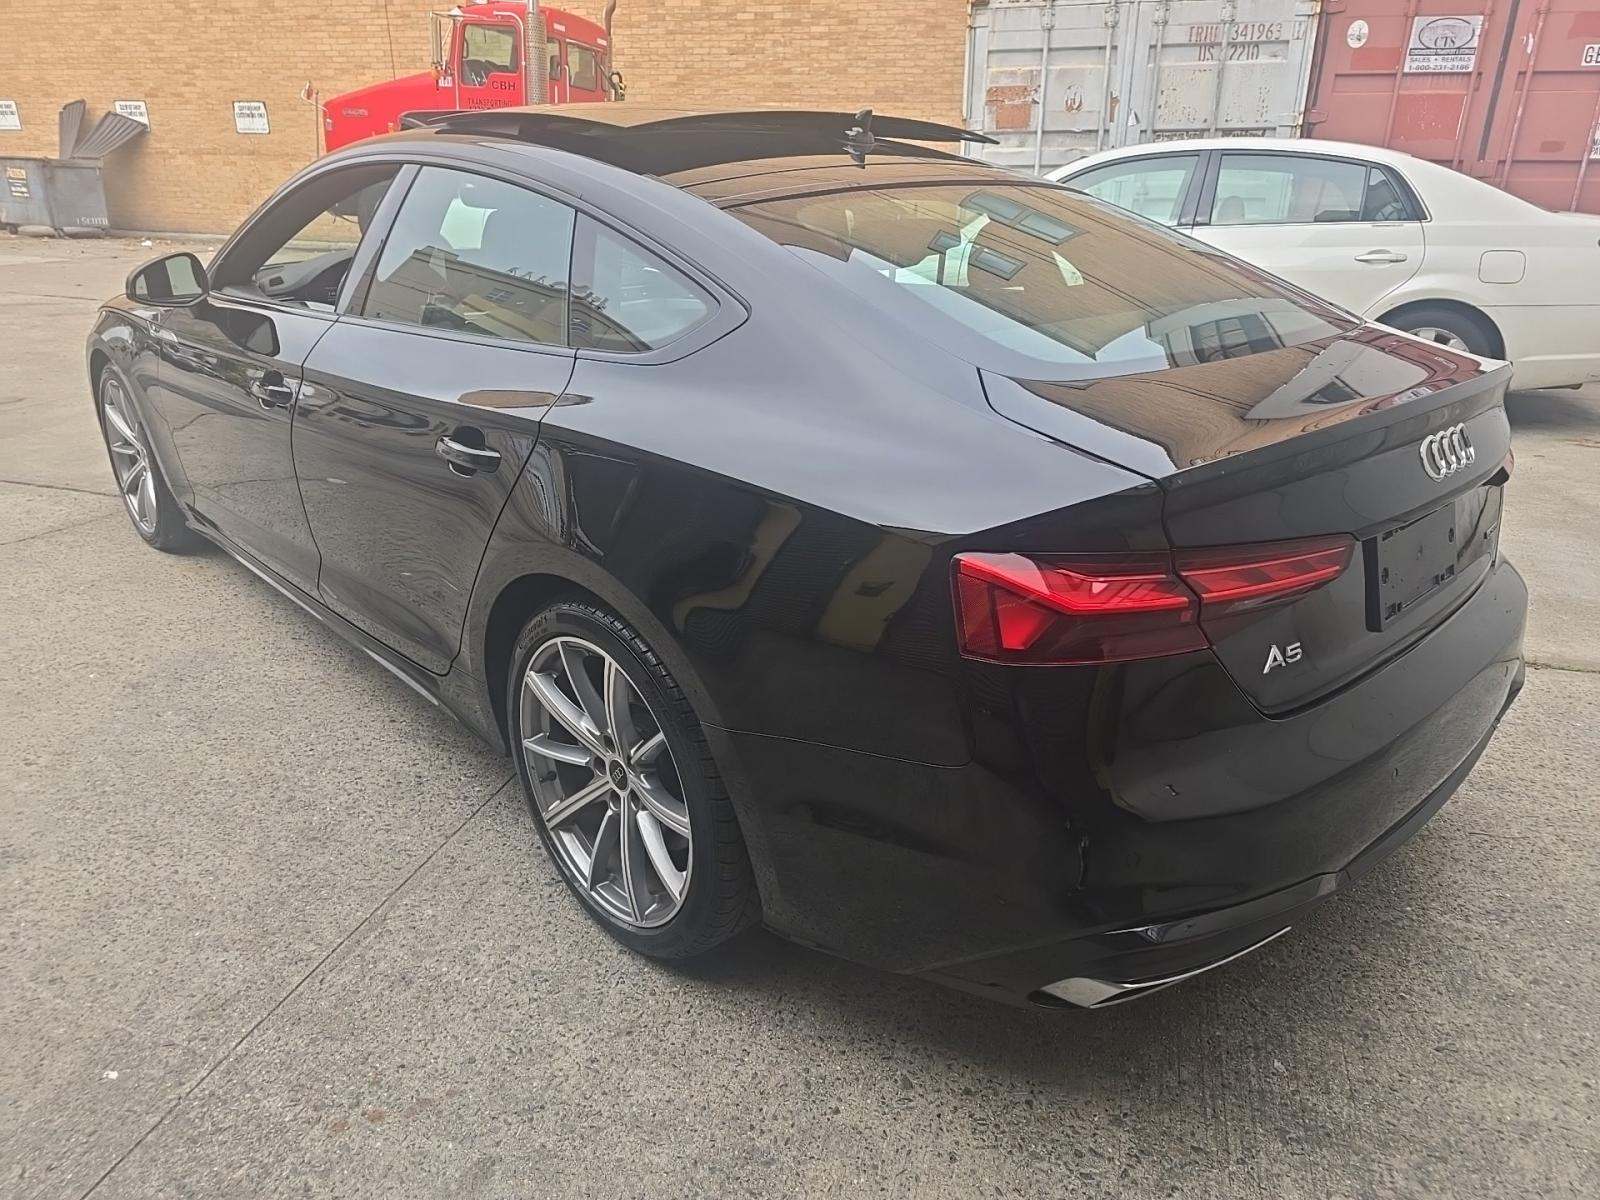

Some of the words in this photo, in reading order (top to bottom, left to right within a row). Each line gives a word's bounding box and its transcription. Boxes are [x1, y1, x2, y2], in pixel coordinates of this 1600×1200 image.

[1231, 23, 1282, 41] 341963
[1199, 44, 1215, 61] US
[1229, 44, 1260, 61] 2210
[1263, 642, 1302, 674] A5
